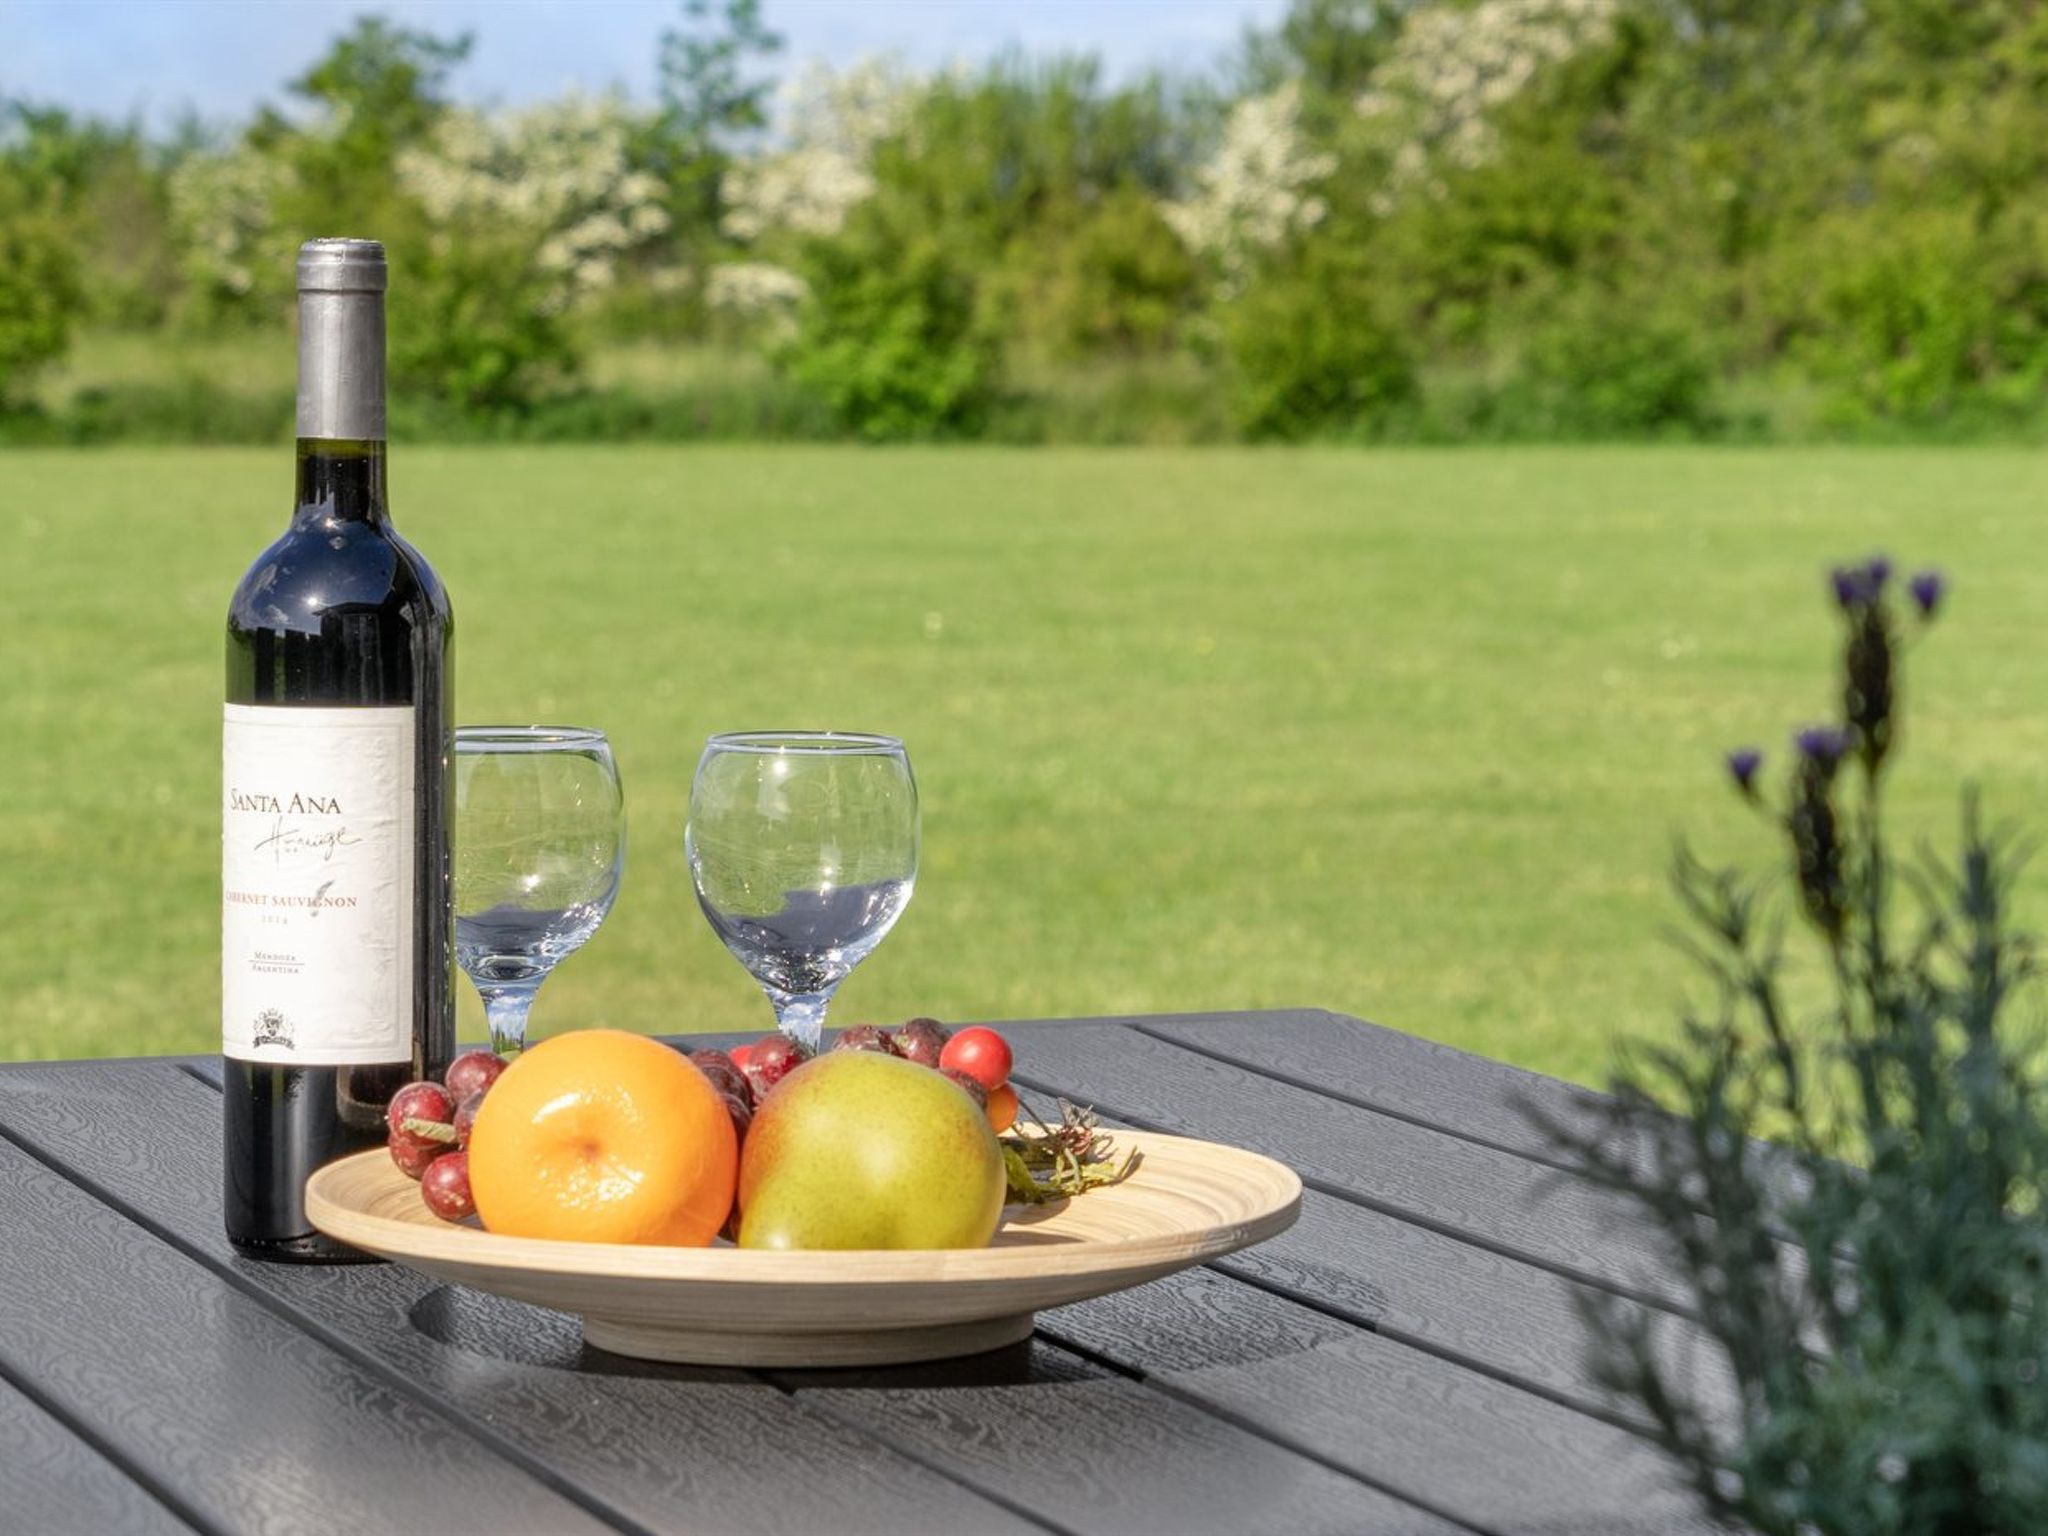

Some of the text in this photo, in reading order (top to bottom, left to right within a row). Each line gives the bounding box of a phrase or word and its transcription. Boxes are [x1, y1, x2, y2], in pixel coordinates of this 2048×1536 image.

[230, 787, 342, 815] SANTA ANA
[271, 895, 358, 908] SAUVIGNON
